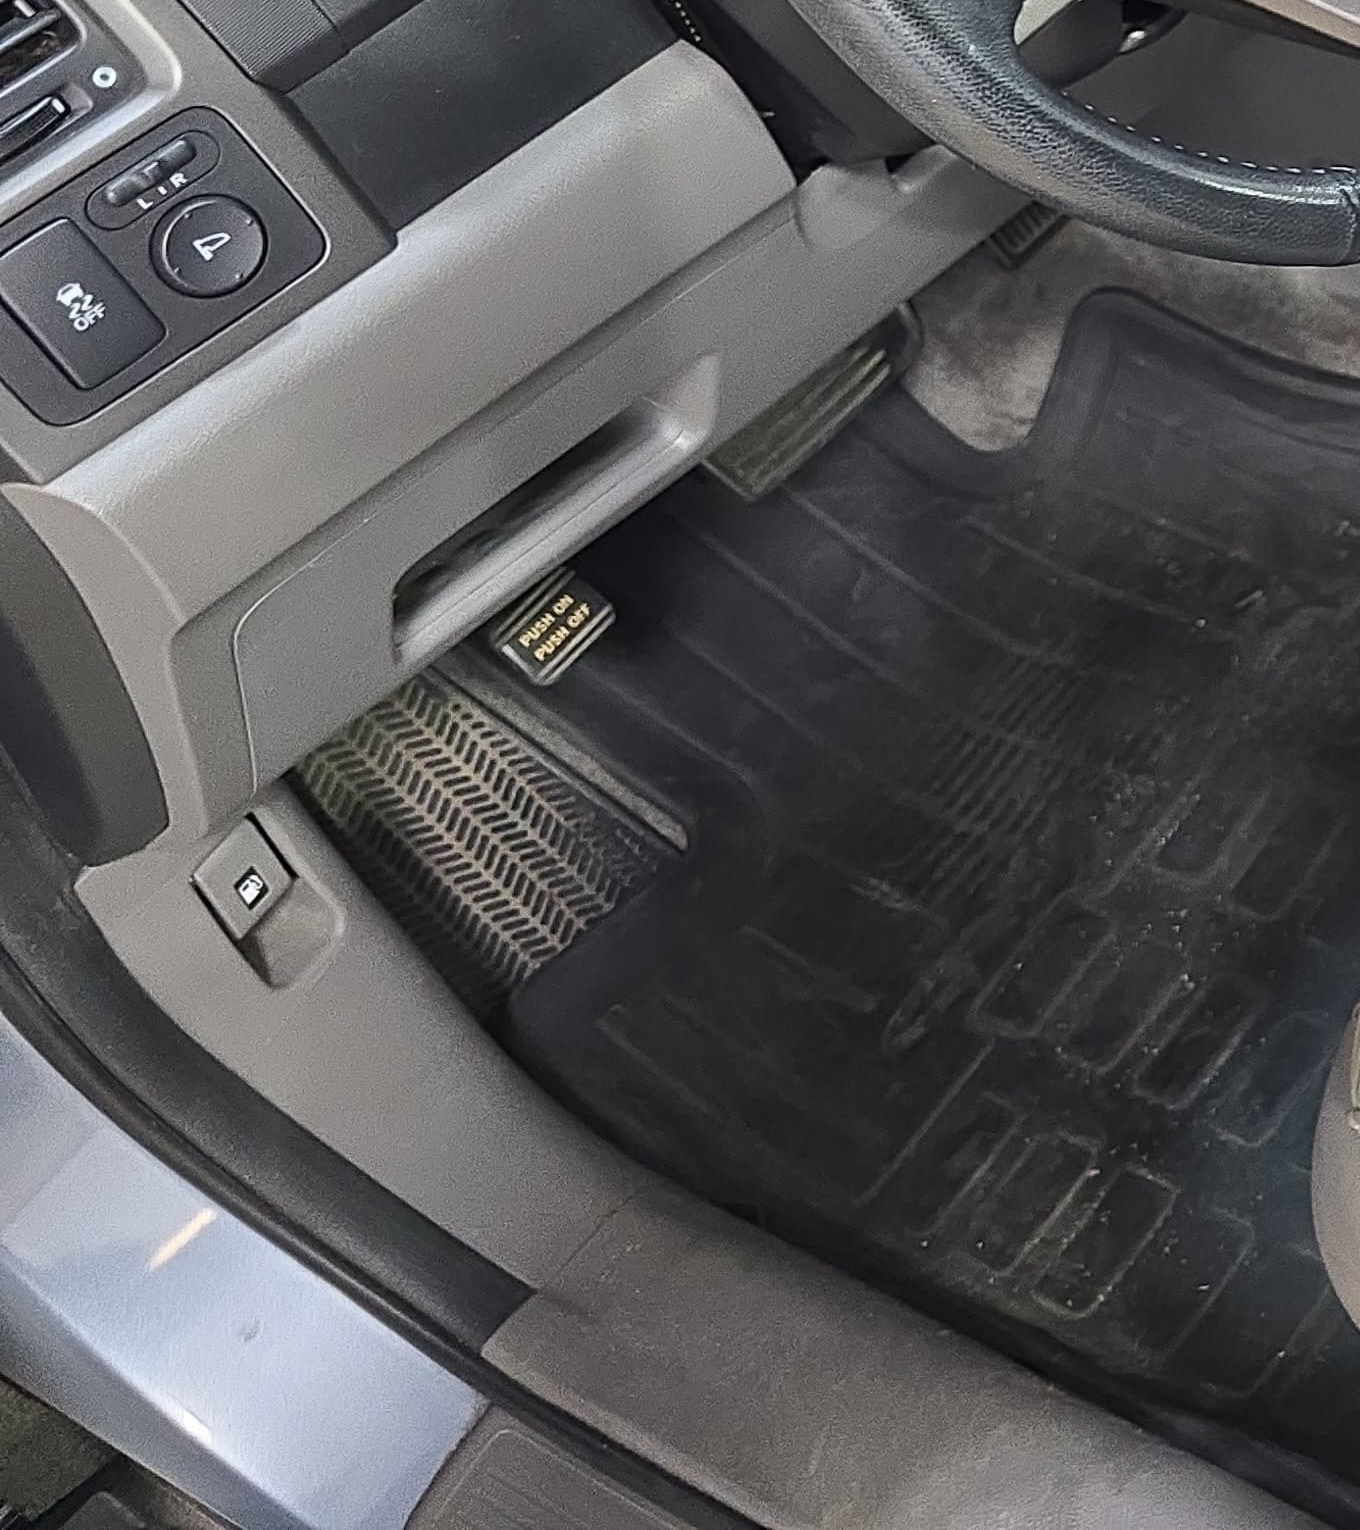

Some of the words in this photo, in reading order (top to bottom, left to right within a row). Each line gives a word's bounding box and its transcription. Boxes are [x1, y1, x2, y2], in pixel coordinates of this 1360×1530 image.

[135, 198, 154, 210] L
[169, 172, 188, 189] R
[73, 302, 106, 332] OFF
[518, 612, 556, 648] PUSH
[551, 593, 575, 615] ON
[533, 625, 571, 662] PUSH
[566, 602, 591, 628] OFF
